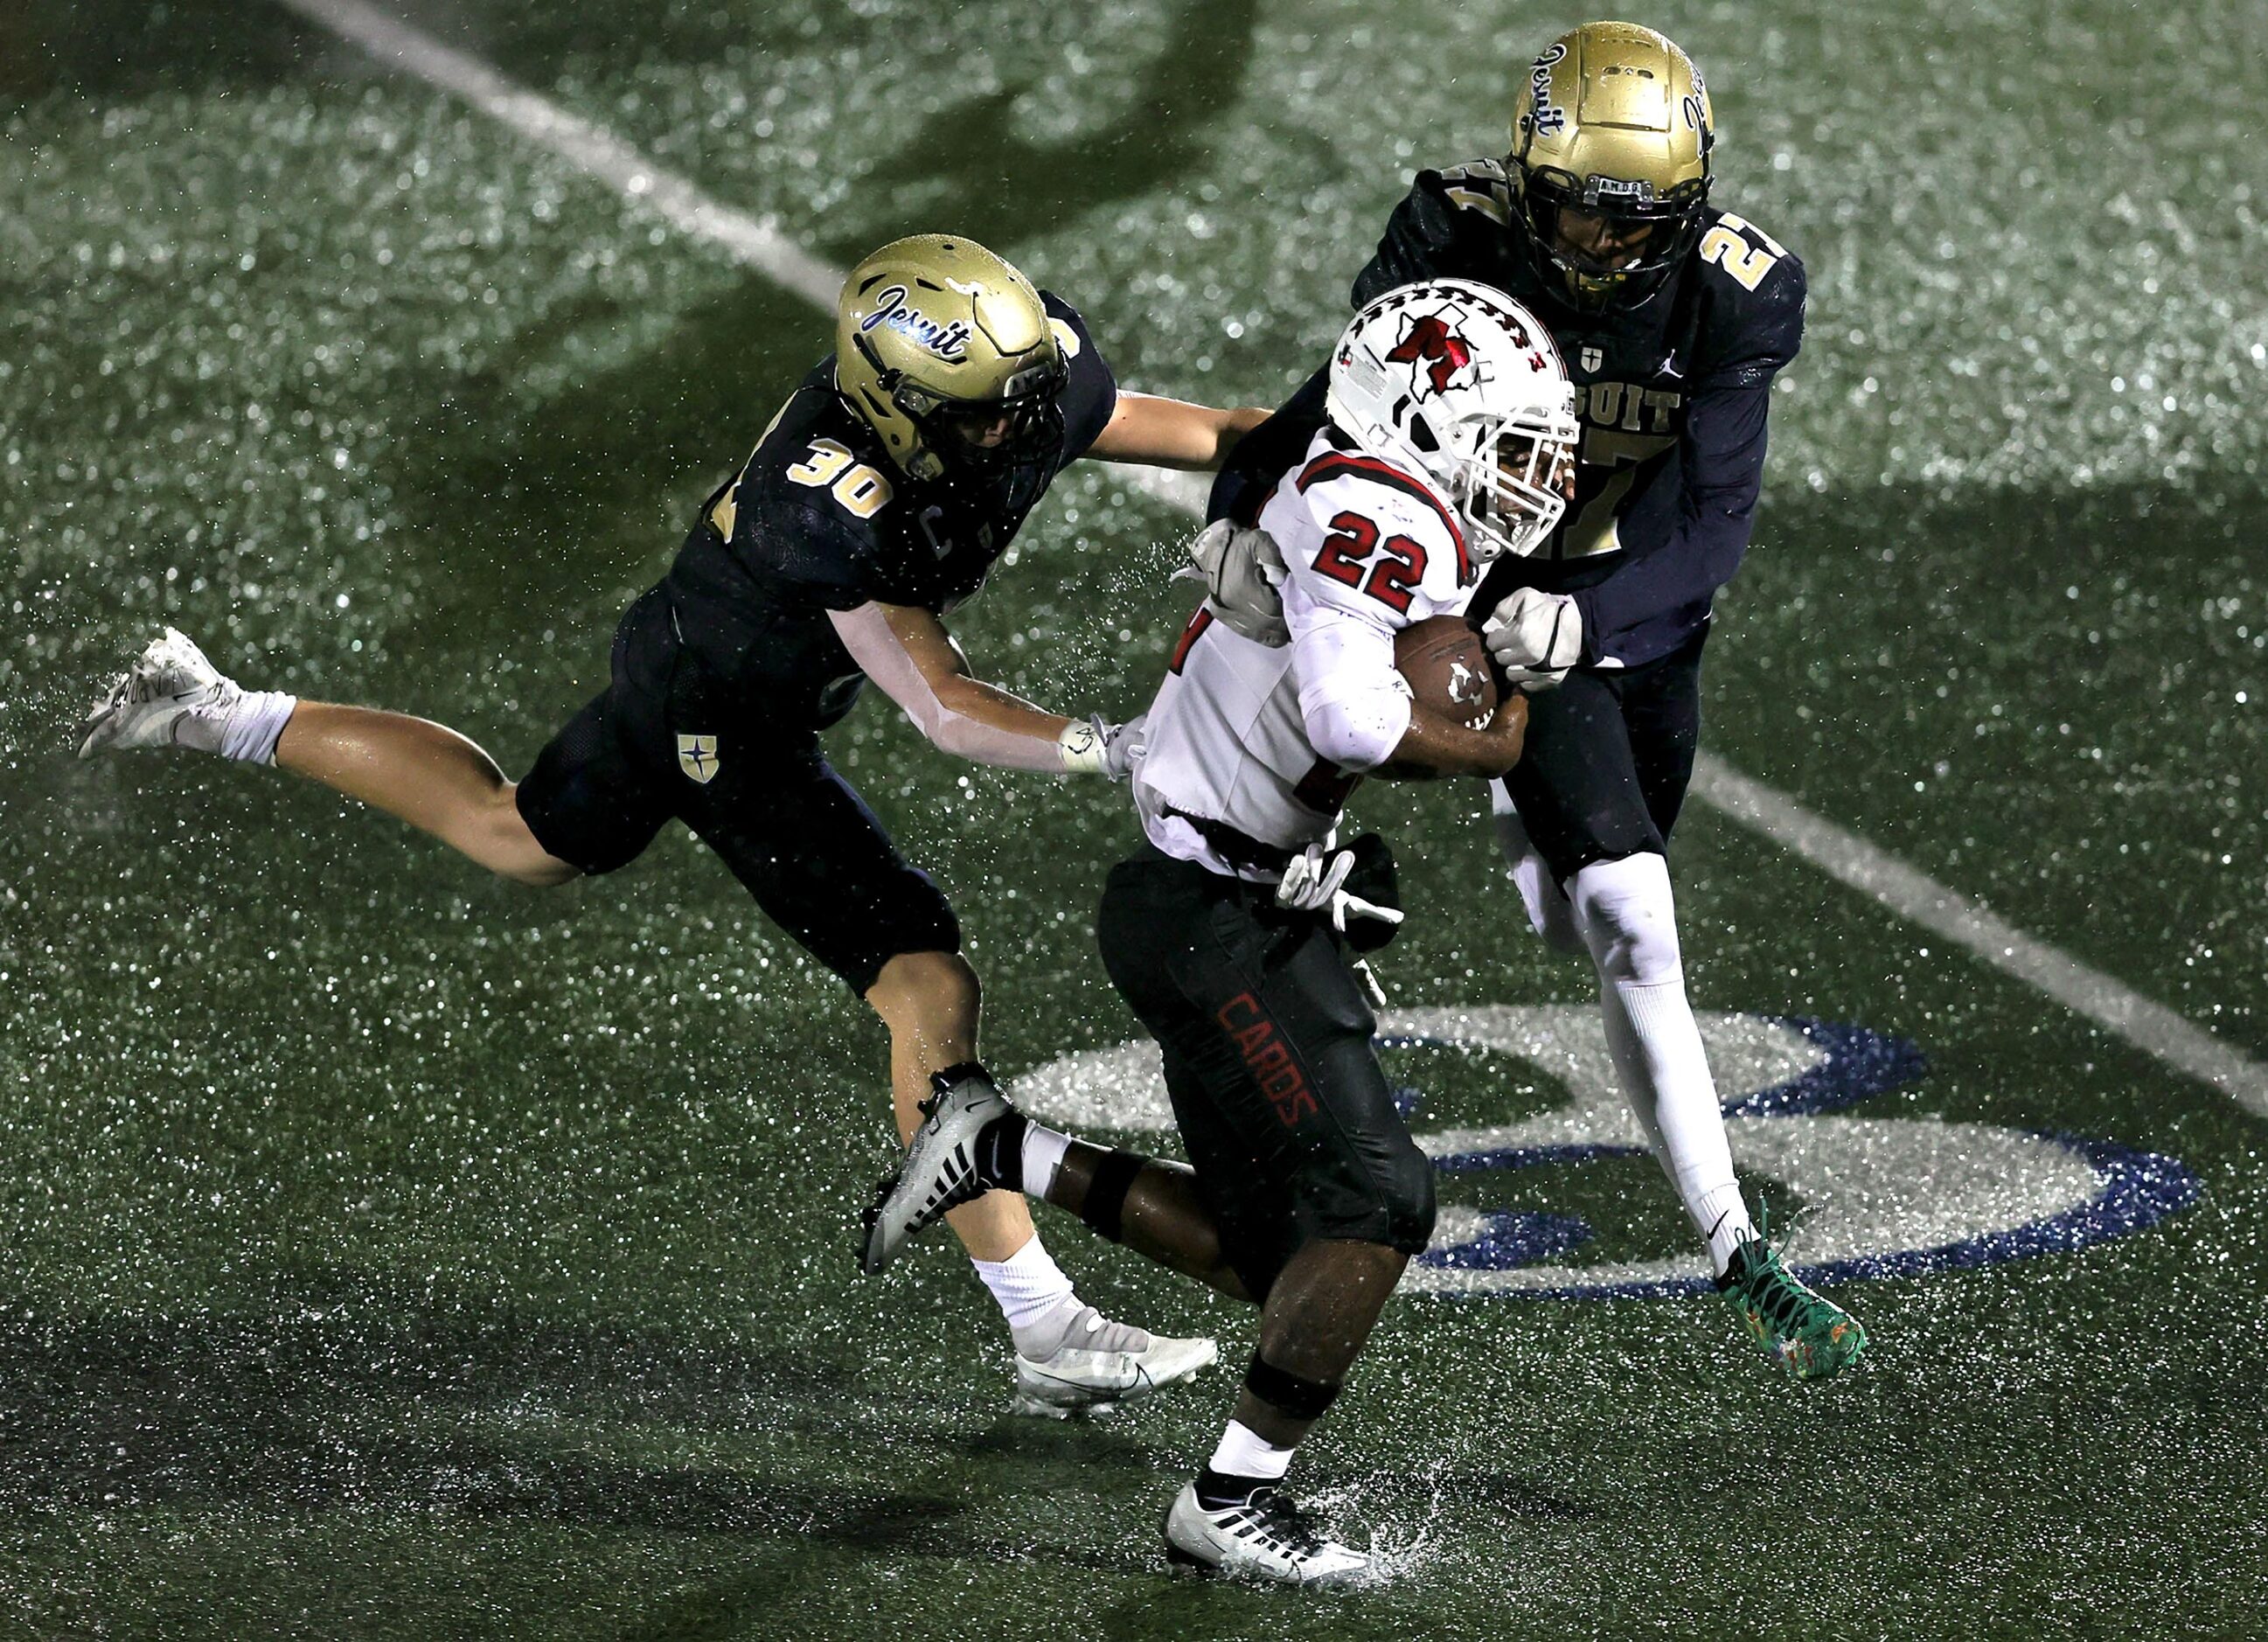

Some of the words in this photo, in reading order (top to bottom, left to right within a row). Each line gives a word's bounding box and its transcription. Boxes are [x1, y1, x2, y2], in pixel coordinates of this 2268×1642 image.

[861, 284, 972, 358] Jesuit
[785, 437, 894, 519] 30
[919, 504, 953, 560] C
[1310, 510, 1429, 617] 22
[1215, 990, 1318, 1128] CARDS
